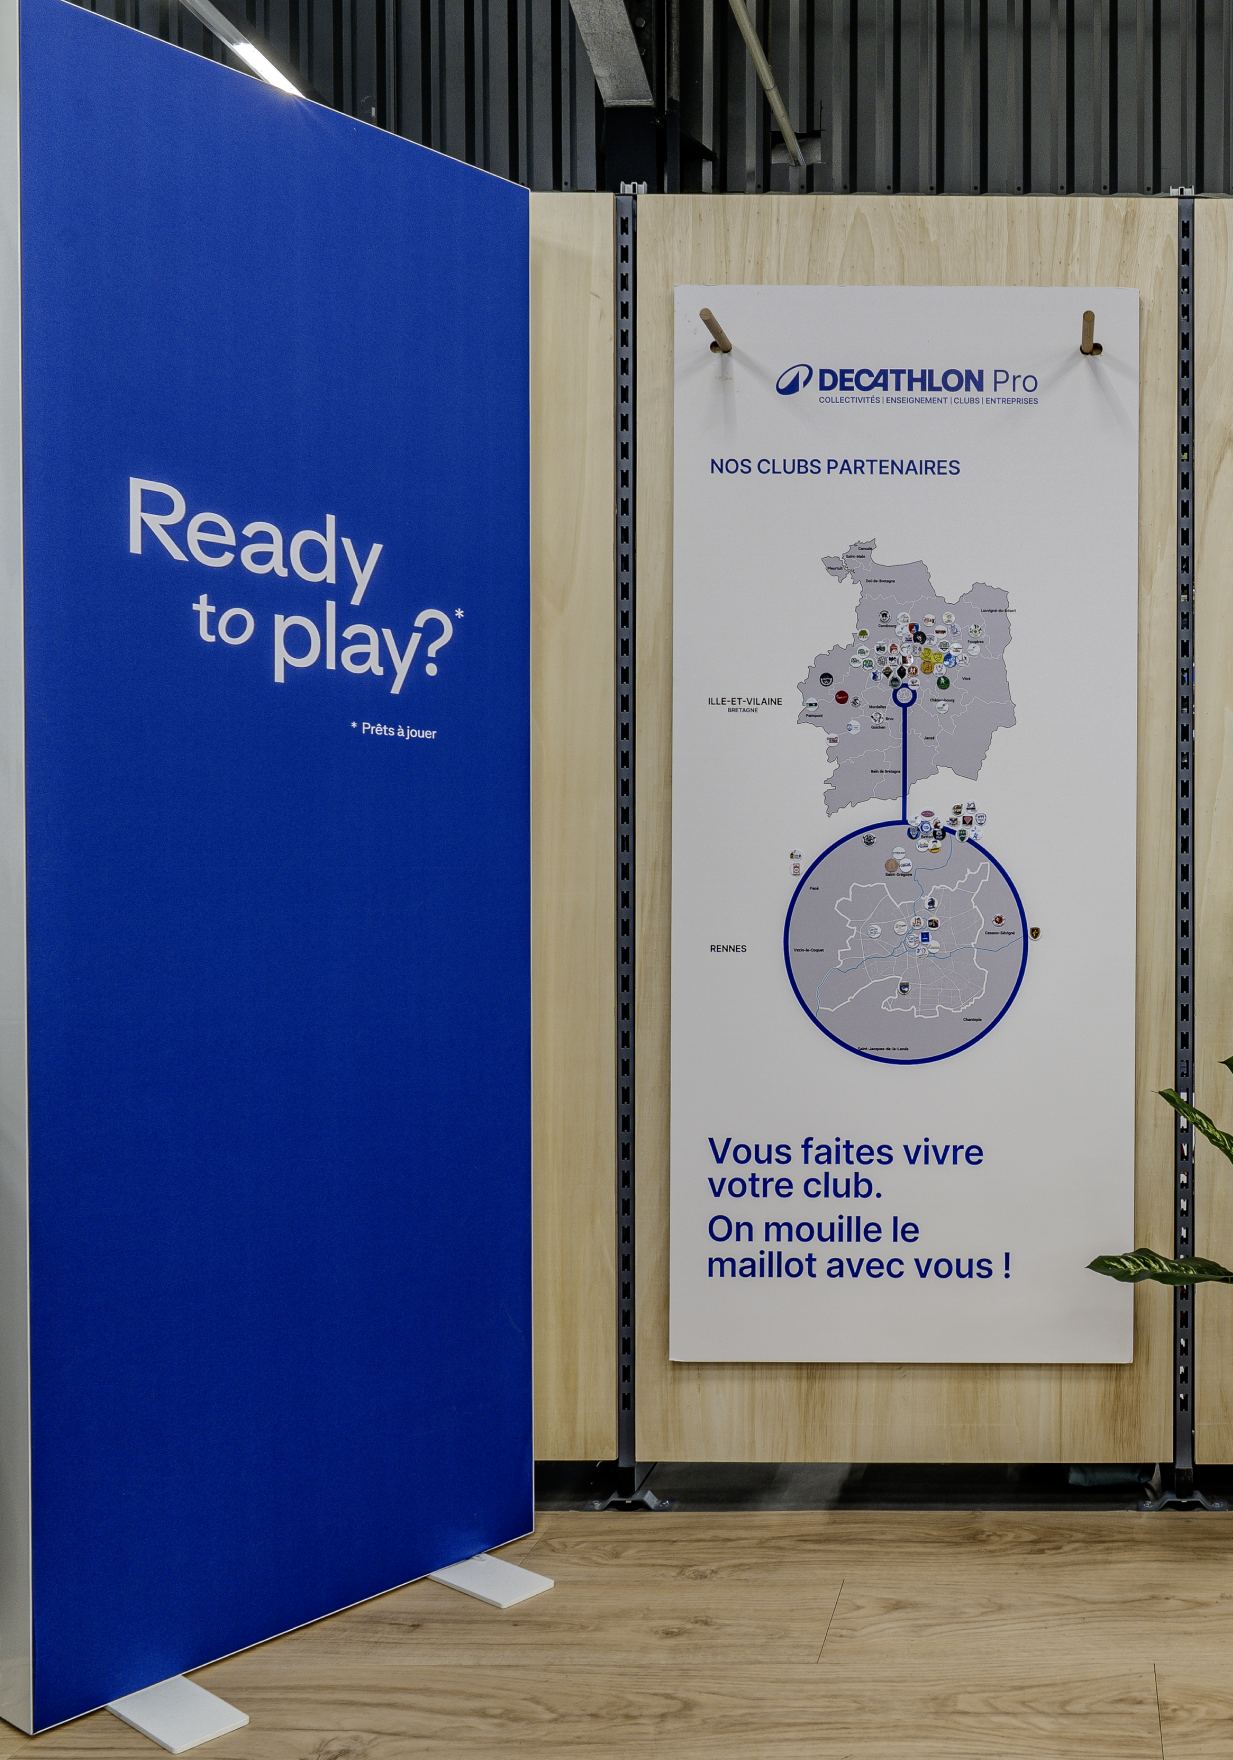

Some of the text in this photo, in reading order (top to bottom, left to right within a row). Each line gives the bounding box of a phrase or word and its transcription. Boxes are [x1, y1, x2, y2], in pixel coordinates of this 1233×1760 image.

[819, 369, 1038, 392] DECATHLON Pro
[819, 396, 881, 405] COLLECTIVITÉS
[711, 458, 960, 475] NOS CLUBS PARTENAIRES
[129, 476, 383, 606] Ready
[192, 594, 255, 645] to
[362, 721, 394, 737] Prêts
[396, 726, 404, 737] à
[406, 725, 437, 739] jouer
[708, 1137, 984, 1165] Vous faites vivre
[708, 1172, 882, 1198] votre club.
[708, 1215, 919, 1242] On mouille le
[708, 1250, 817, 1278] maillot
[826, 1256, 905, 1278] avec
[915, 1257, 993, 1279] vous
